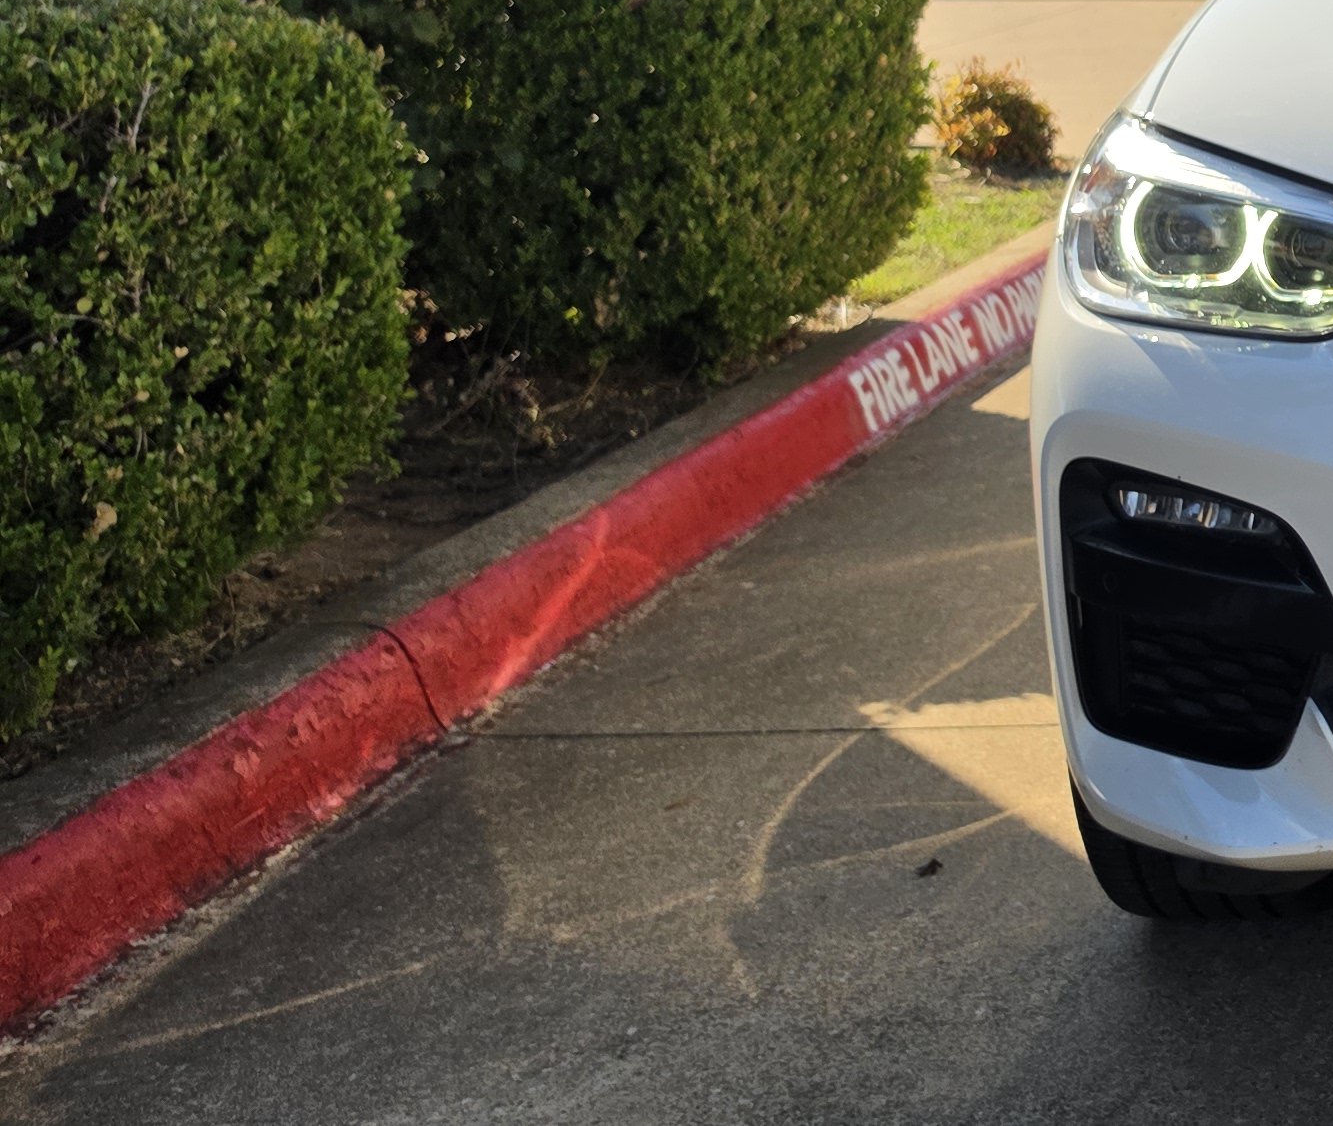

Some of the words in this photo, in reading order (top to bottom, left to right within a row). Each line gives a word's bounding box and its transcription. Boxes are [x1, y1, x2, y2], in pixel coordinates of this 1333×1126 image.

[848, 348, 919, 432] FIRE
[904, 309, 979, 394] LANE
[968, 292, 1017, 357] NO
